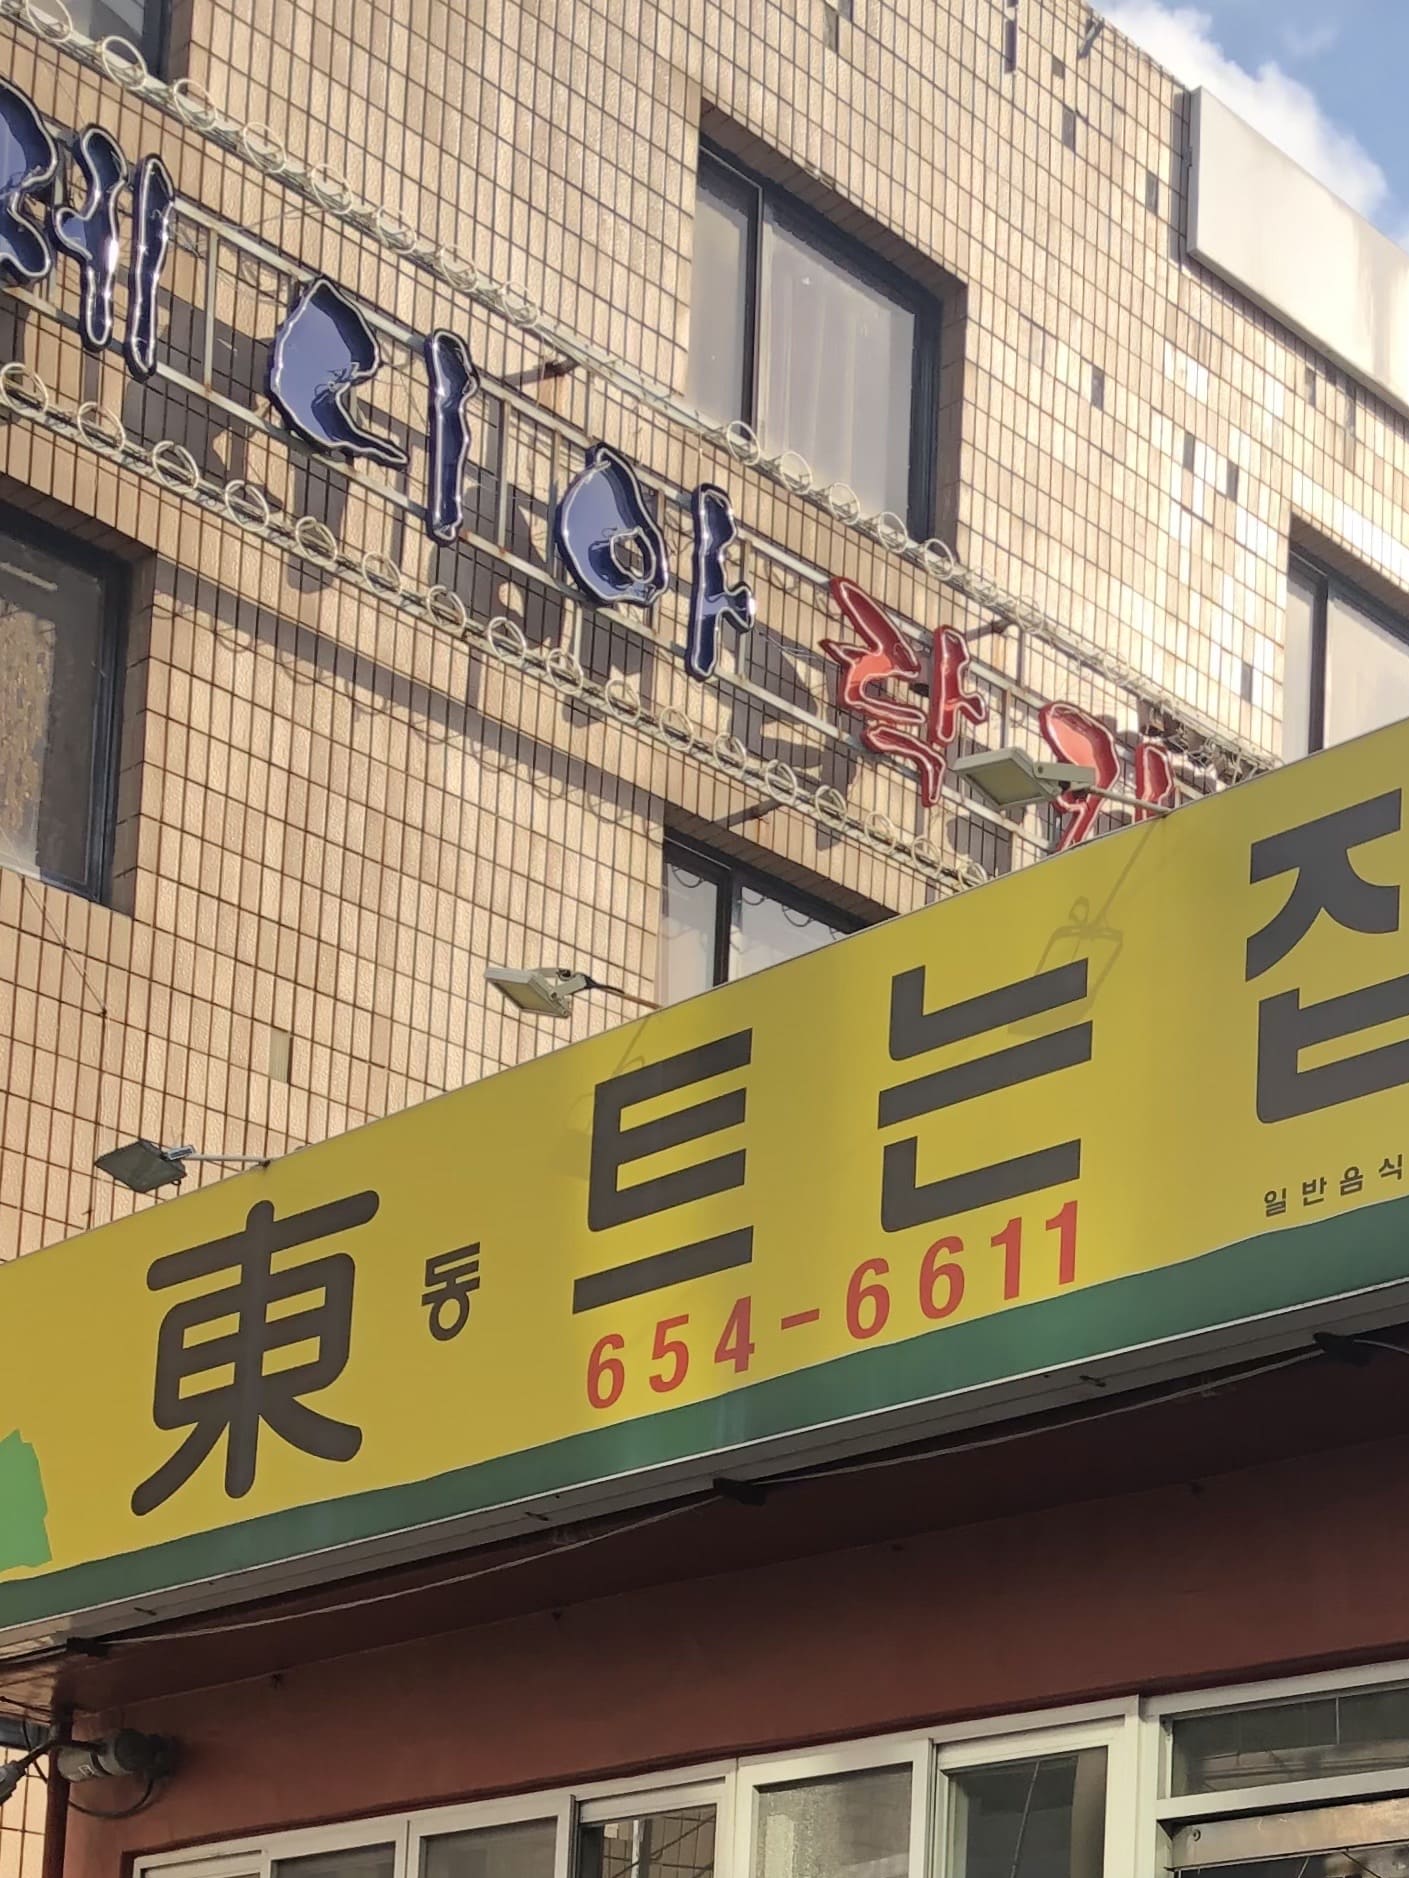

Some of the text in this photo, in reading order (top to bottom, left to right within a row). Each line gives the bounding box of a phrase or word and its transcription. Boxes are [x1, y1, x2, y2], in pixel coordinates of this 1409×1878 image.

[131, 1190, 380, 1516] 東
[421, 1241, 481, 1341] 동
[586, 1200, 1079, 1410] 654-6611
